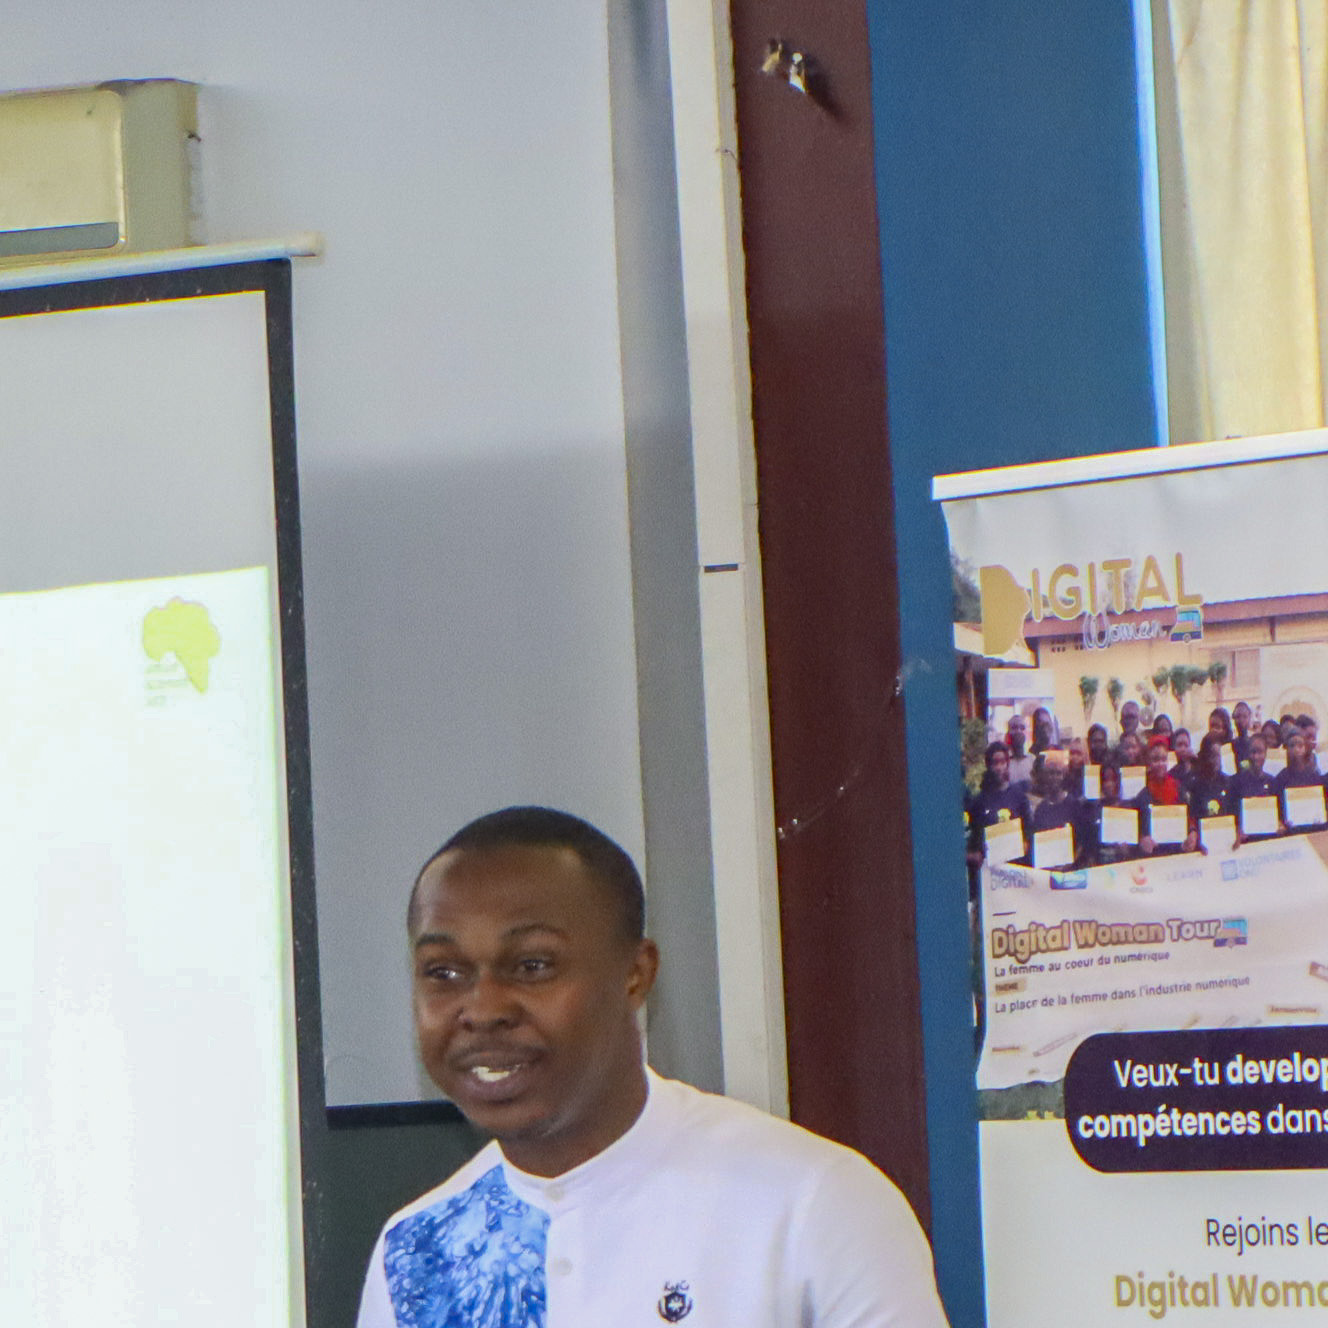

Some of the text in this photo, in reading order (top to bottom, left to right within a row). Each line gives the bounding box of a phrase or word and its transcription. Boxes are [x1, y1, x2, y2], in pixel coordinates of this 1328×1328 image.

[979, 551, 1203, 656] DIGITAL
[1083, 609, 1167, 651] Women
[992, 917, 1222, 963] Digital Woman Tour
[994, 950, 1170, 978] La femme au coeur du numérique
[995, 1003, 1006, 1014] La
[1041, 997, 1055, 1008] de
[1057, 995, 1067, 1006] la
[1071, 991, 1108, 1004] femme
[1111, 987, 1136, 1001] dans
[1139, 979, 1192, 999] l'industrie
[1195, 975, 1250, 994] numérique
[1114, 1057, 1221, 1088] Veux-tu
[1078, 1105, 1261, 1146] compétences
[1206, 1217, 1299, 1256] Rejoins
[1114, 1271, 1220, 1319] Digital
